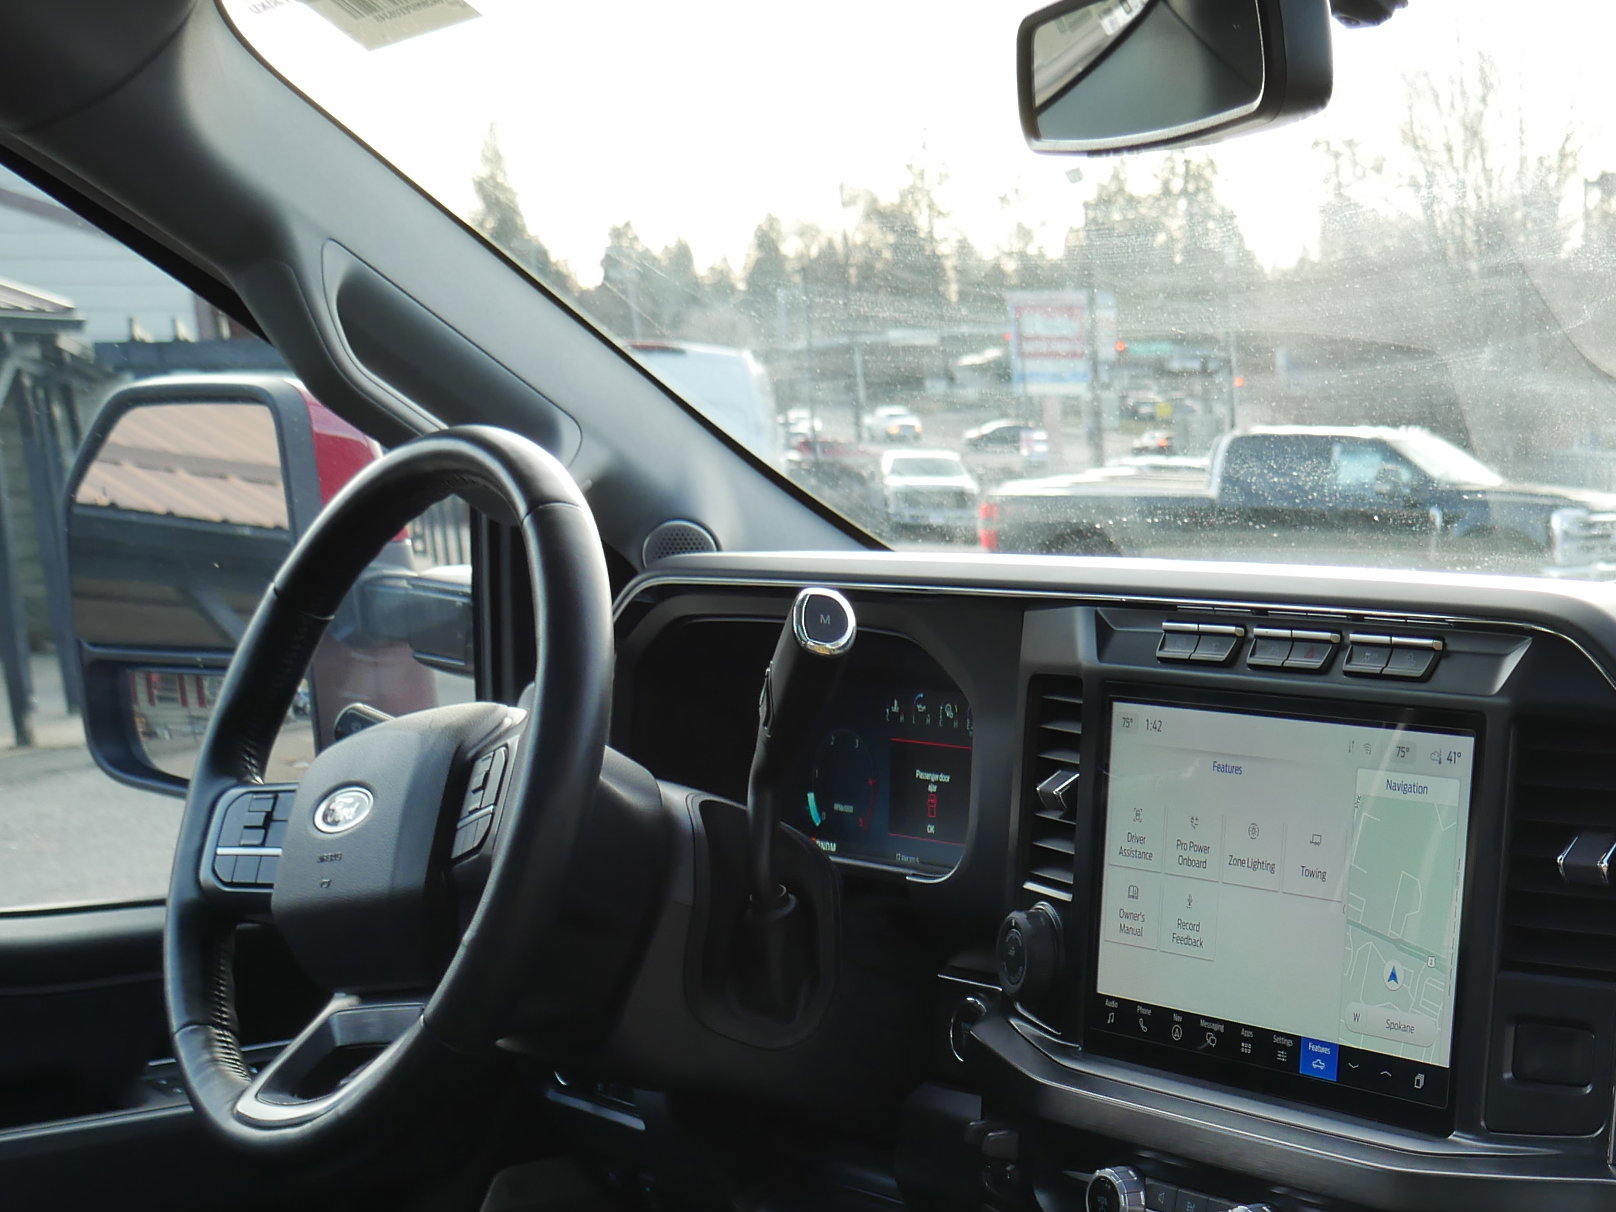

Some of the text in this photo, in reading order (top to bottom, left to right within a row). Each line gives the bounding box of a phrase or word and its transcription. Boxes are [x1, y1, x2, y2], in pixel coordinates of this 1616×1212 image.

[819, 614, 831, 625] M
[1145, 719, 1163, 732] 1:42
[1446, 751, 1462, 764] 41°
[1212, 760, 1243, 775] Features
[1386, 778, 1428, 795] Navigation
[926, 824, 935, 834] OK
[1127, 831, 1146, 845] Driver
[1118, 846, 1153, 861] Assistance
[1176, 839, 1211, 855] Pro Power
[1177, 855, 1207, 870] Onboard
[1228, 855, 1276, 874] Zone Lighting
[1300, 865, 1327, 882] Towing
[1118, 907, 1146, 923] Owner's
[1119, 923, 1144, 937] Manual
[1176, 918, 1201, 933] Record
[1171, 932, 1204, 948] Feedback
[1105, 999, 1119, 1009] Audio
[1136, 1005, 1152, 1016] Phone
[1173, 1013, 1183, 1022] Nav
[1353, 1012, 1415, 1034] W Spokane
[1200, 1019, 1225, 1033] Messaging
[1240, 1027, 1254, 1038] Apps
[1272, 1035, 1294, 1047] Settings
[1308, 1042, 1331, 1055] Features
